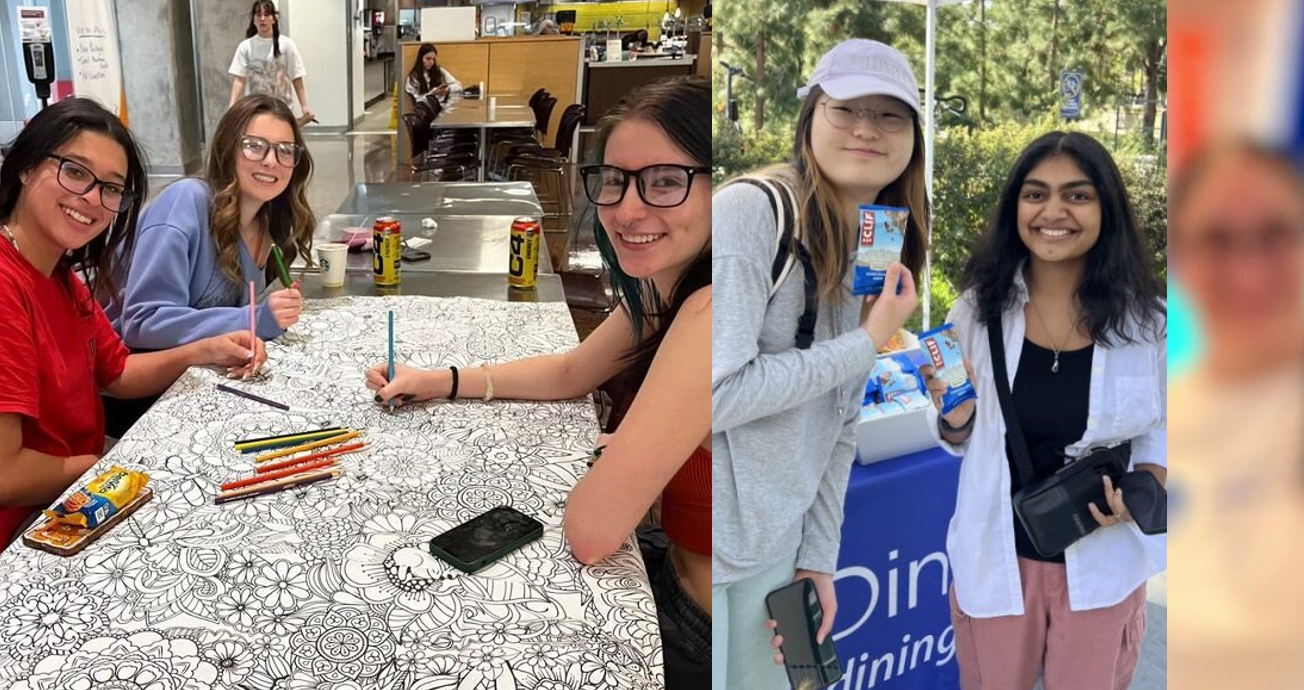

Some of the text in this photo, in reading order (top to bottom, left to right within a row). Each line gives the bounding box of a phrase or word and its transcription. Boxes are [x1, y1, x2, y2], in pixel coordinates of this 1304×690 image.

[373, 232, 384, 276] C4
[510, 233, 525, 277] C4
[826, 624, 956, 690] dining
